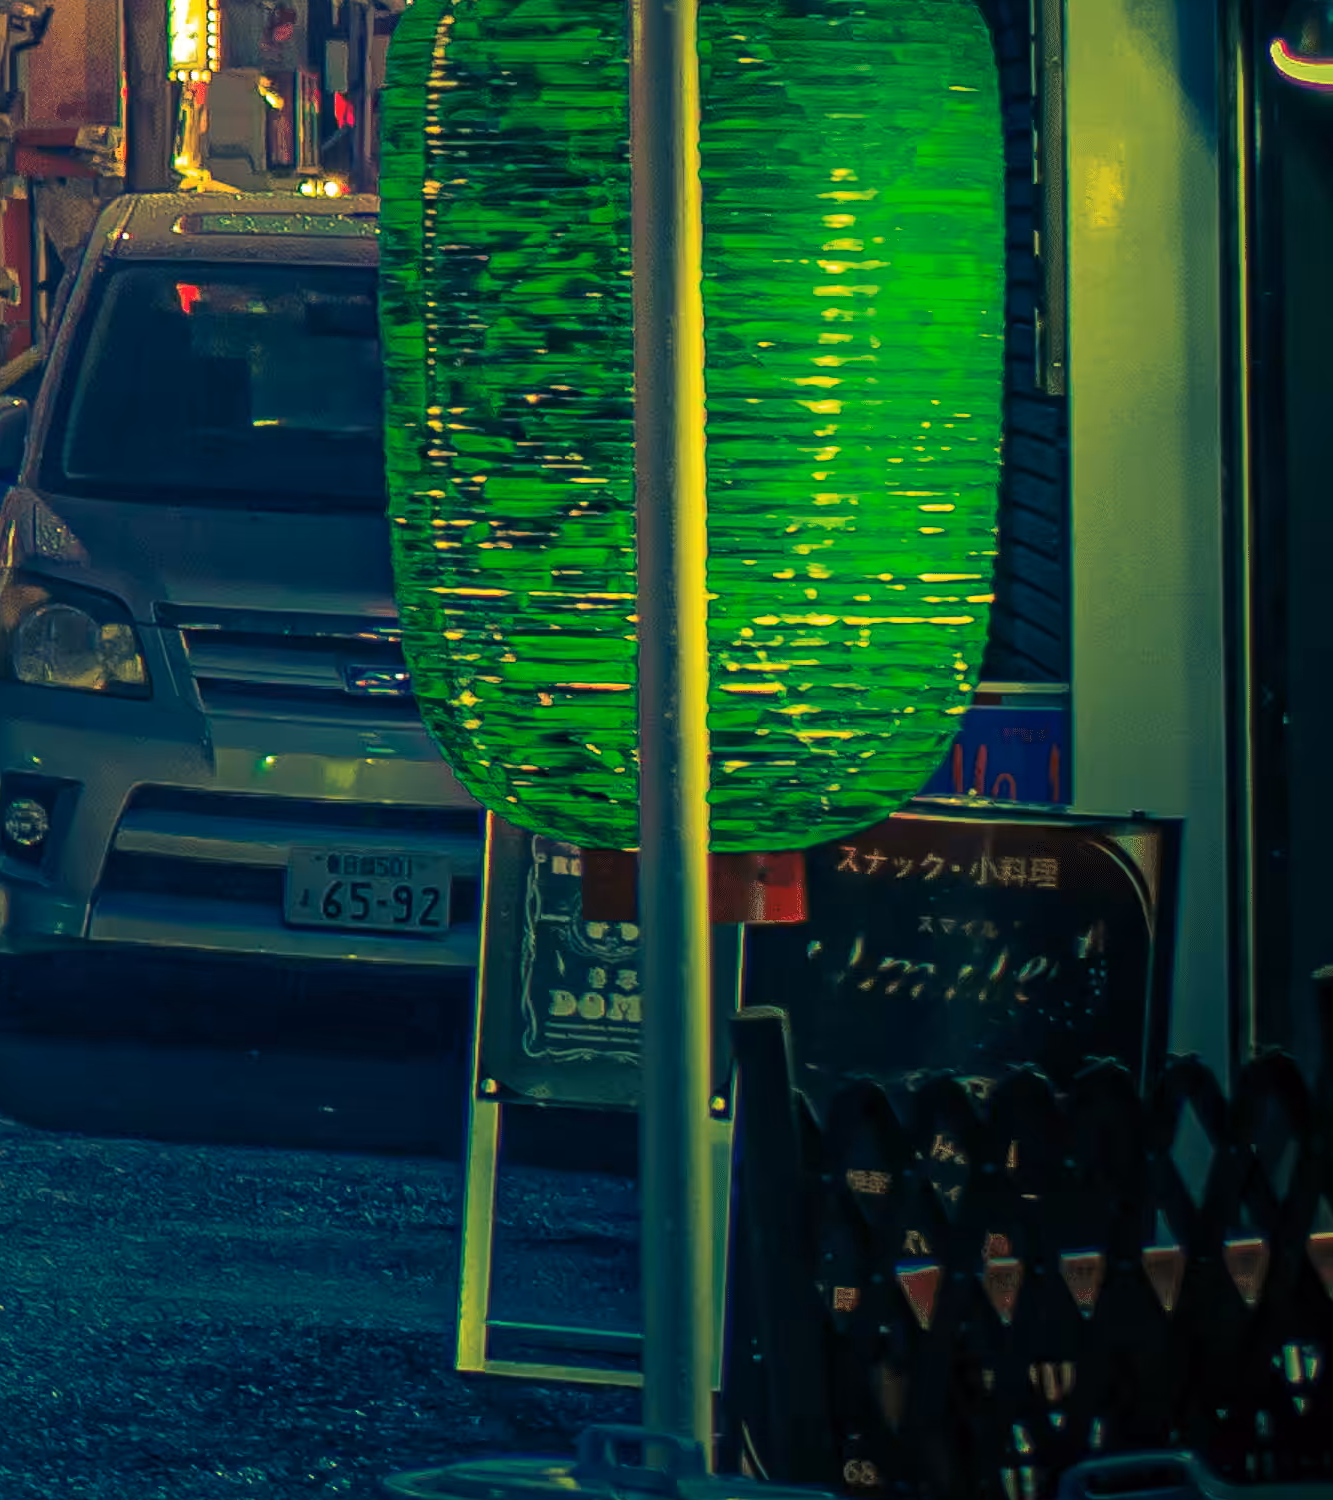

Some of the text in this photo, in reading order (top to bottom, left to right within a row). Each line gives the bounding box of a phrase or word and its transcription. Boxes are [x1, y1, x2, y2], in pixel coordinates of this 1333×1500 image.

[837, 845, 1061, 888] スナック・小料理
[323, 881, 440, 927] 65-92
